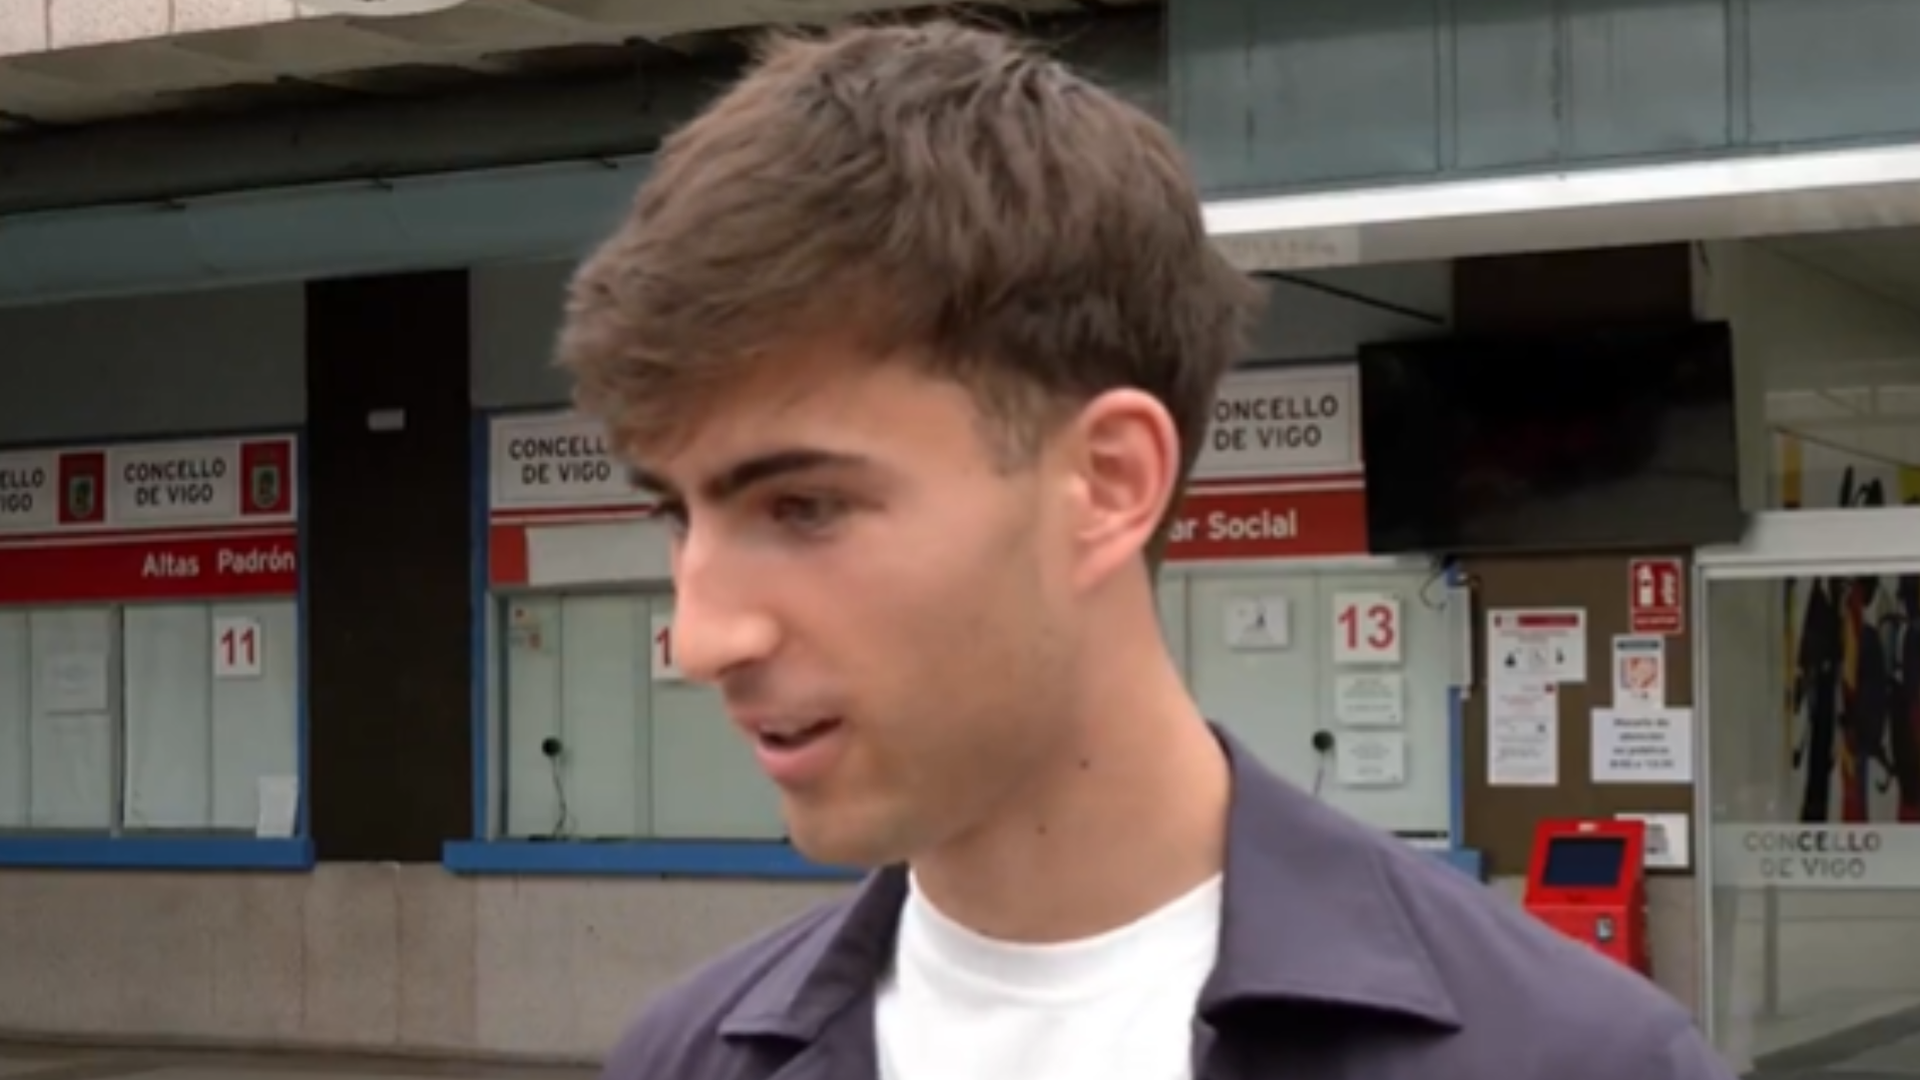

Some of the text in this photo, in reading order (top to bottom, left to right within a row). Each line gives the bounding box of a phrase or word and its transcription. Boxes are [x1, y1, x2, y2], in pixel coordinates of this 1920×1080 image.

[1214, 394, 1339, 422] ONCELLO
[508, 436, 607, 459] CONCELL
[1213, 424, 1322, 450] DE VIGO
[123, 457, 226, 484] CONCELLO
[521, 461, 611, 484] DE VIGO
[135, 483, 214, 506] DE VIGO
[1208, 509, 1298, 541] Social
[141, 544, 296, 578] Altas Padrón
[1337, 604, 1395, 649] 13
[220, 626, 255, 666] 11
[655, 626, 672, 666] 1
[1742, 829, 1882, 852] CONCELLO
[1760, 856, 1866, 879] DE VIGO
